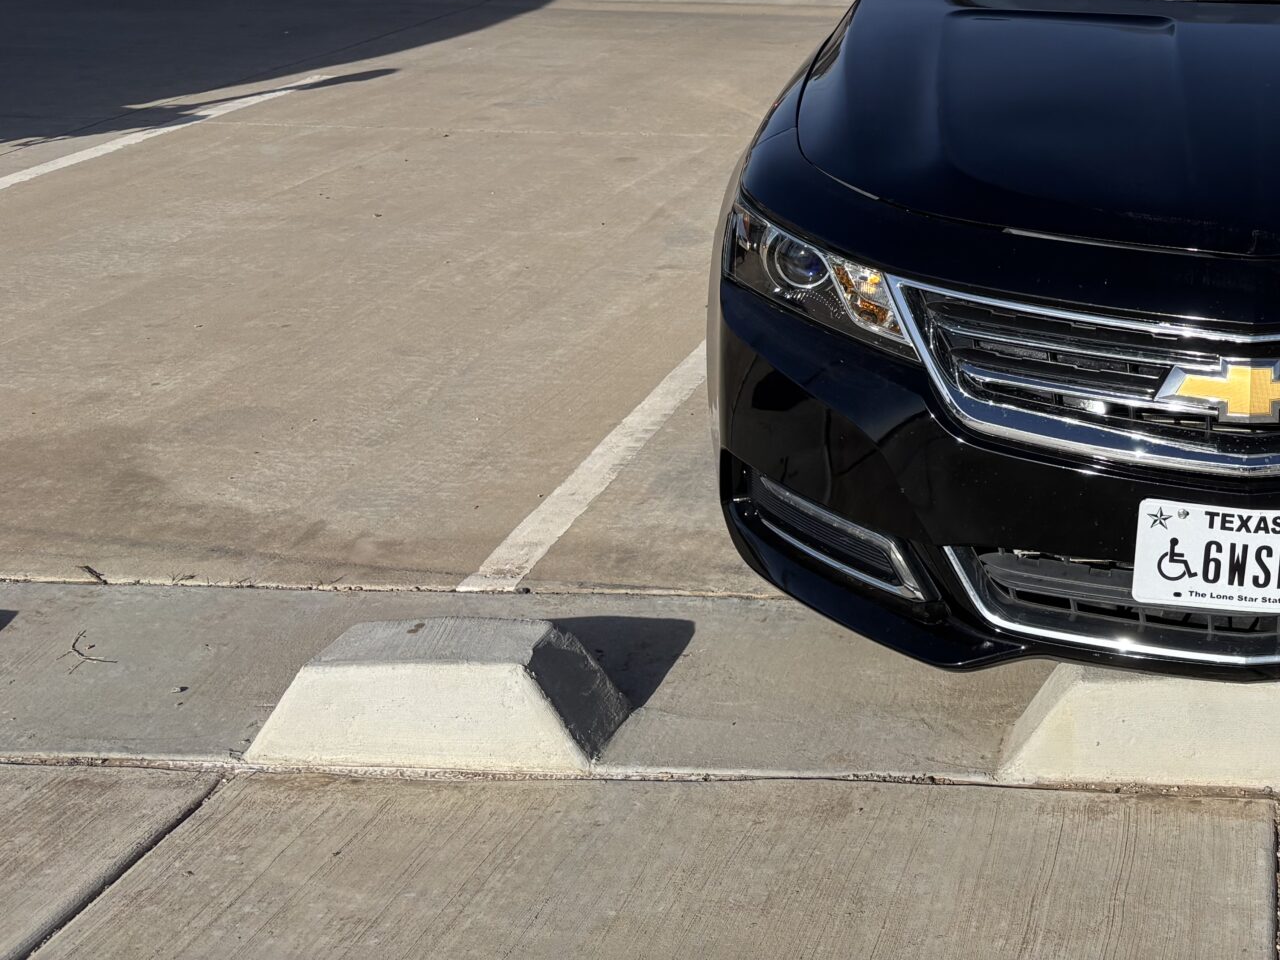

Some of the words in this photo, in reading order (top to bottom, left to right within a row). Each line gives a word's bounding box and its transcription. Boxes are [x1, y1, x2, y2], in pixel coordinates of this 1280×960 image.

[1188, 590, 1207, 598] The
[1209, 592, 1234, 601] Lone
[1237, 594, 1258, 603] Star
